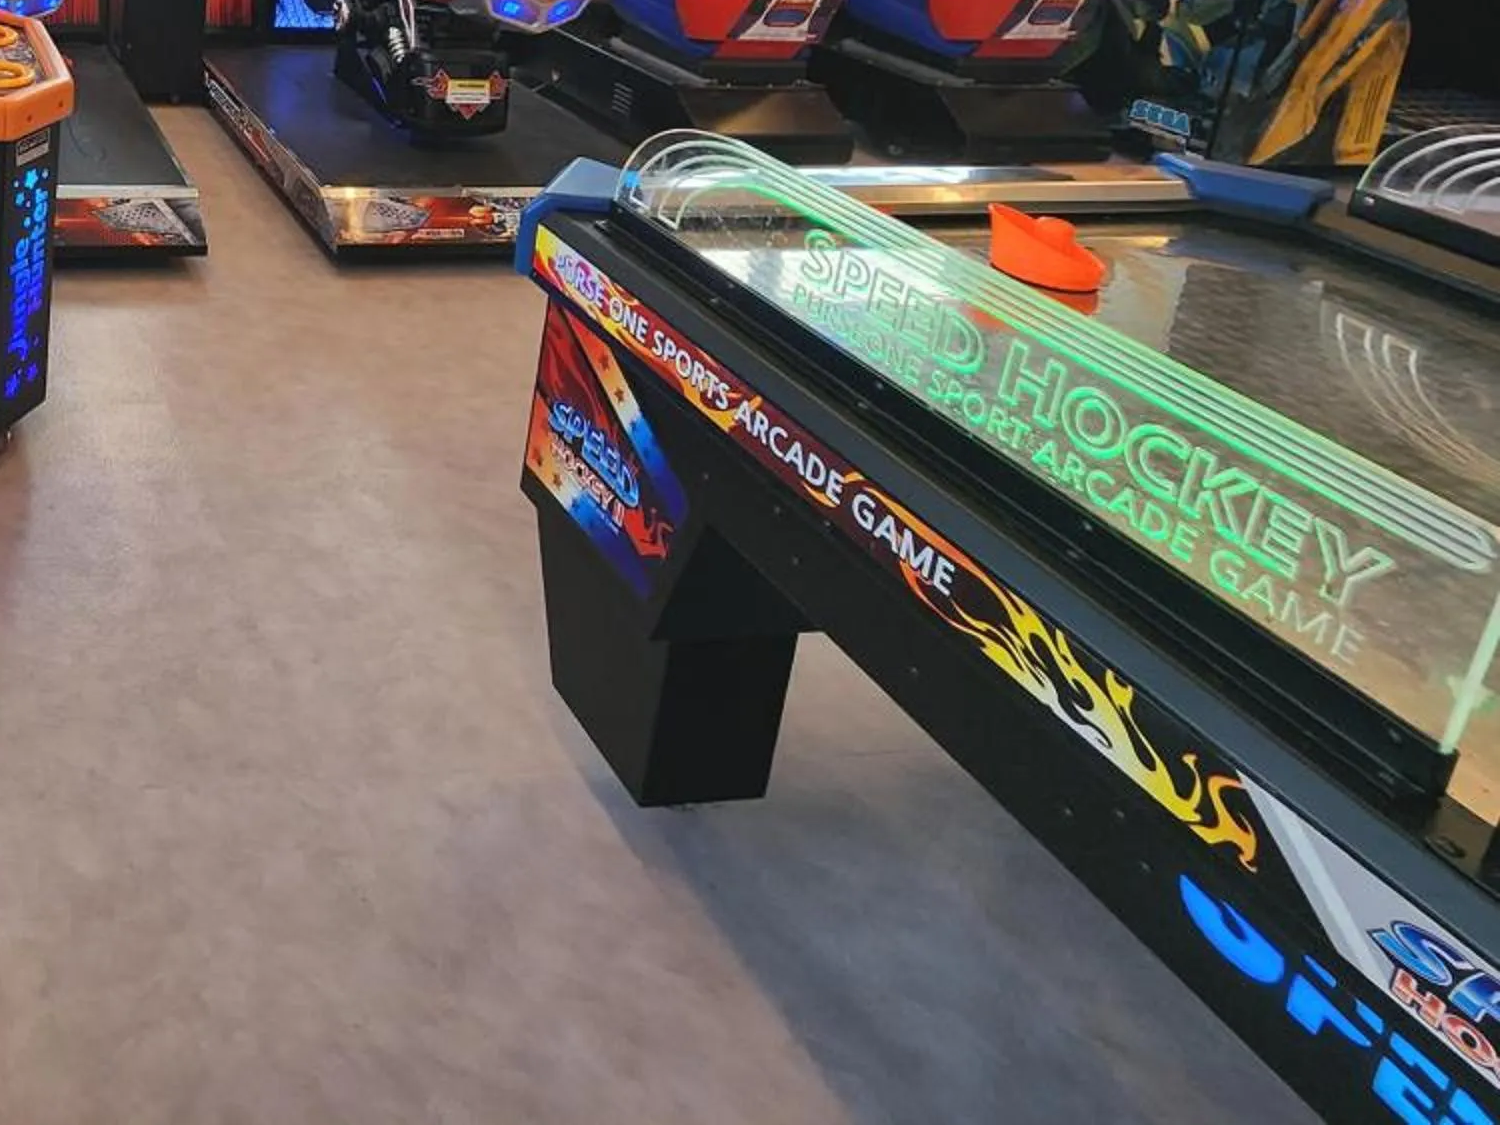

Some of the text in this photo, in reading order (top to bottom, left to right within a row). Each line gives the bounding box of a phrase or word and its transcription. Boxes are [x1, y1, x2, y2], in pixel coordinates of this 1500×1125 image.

[1130, 99, 1191, 137] SEGA
[27, 188, 49, 315] Hunter
[548, 400, 640, 508] SPEED
[549, 432, 614, 511] HOCKEY
[608, 297, 649, 343] ONE
[651, 330, 731, 410] SPORTS
[734, 400, 847, 505] ARCADE
[851, 493, 956, 597] GAME
[799, 229, 1397, 608] SPEED HOCKEY
[865, 330, 922, 386] ONE
[927, 370, 1031, 449] SPORT
[1031, 440, 1200, 564] ARCADE
[1208, 549, 1365, 664] GAME
